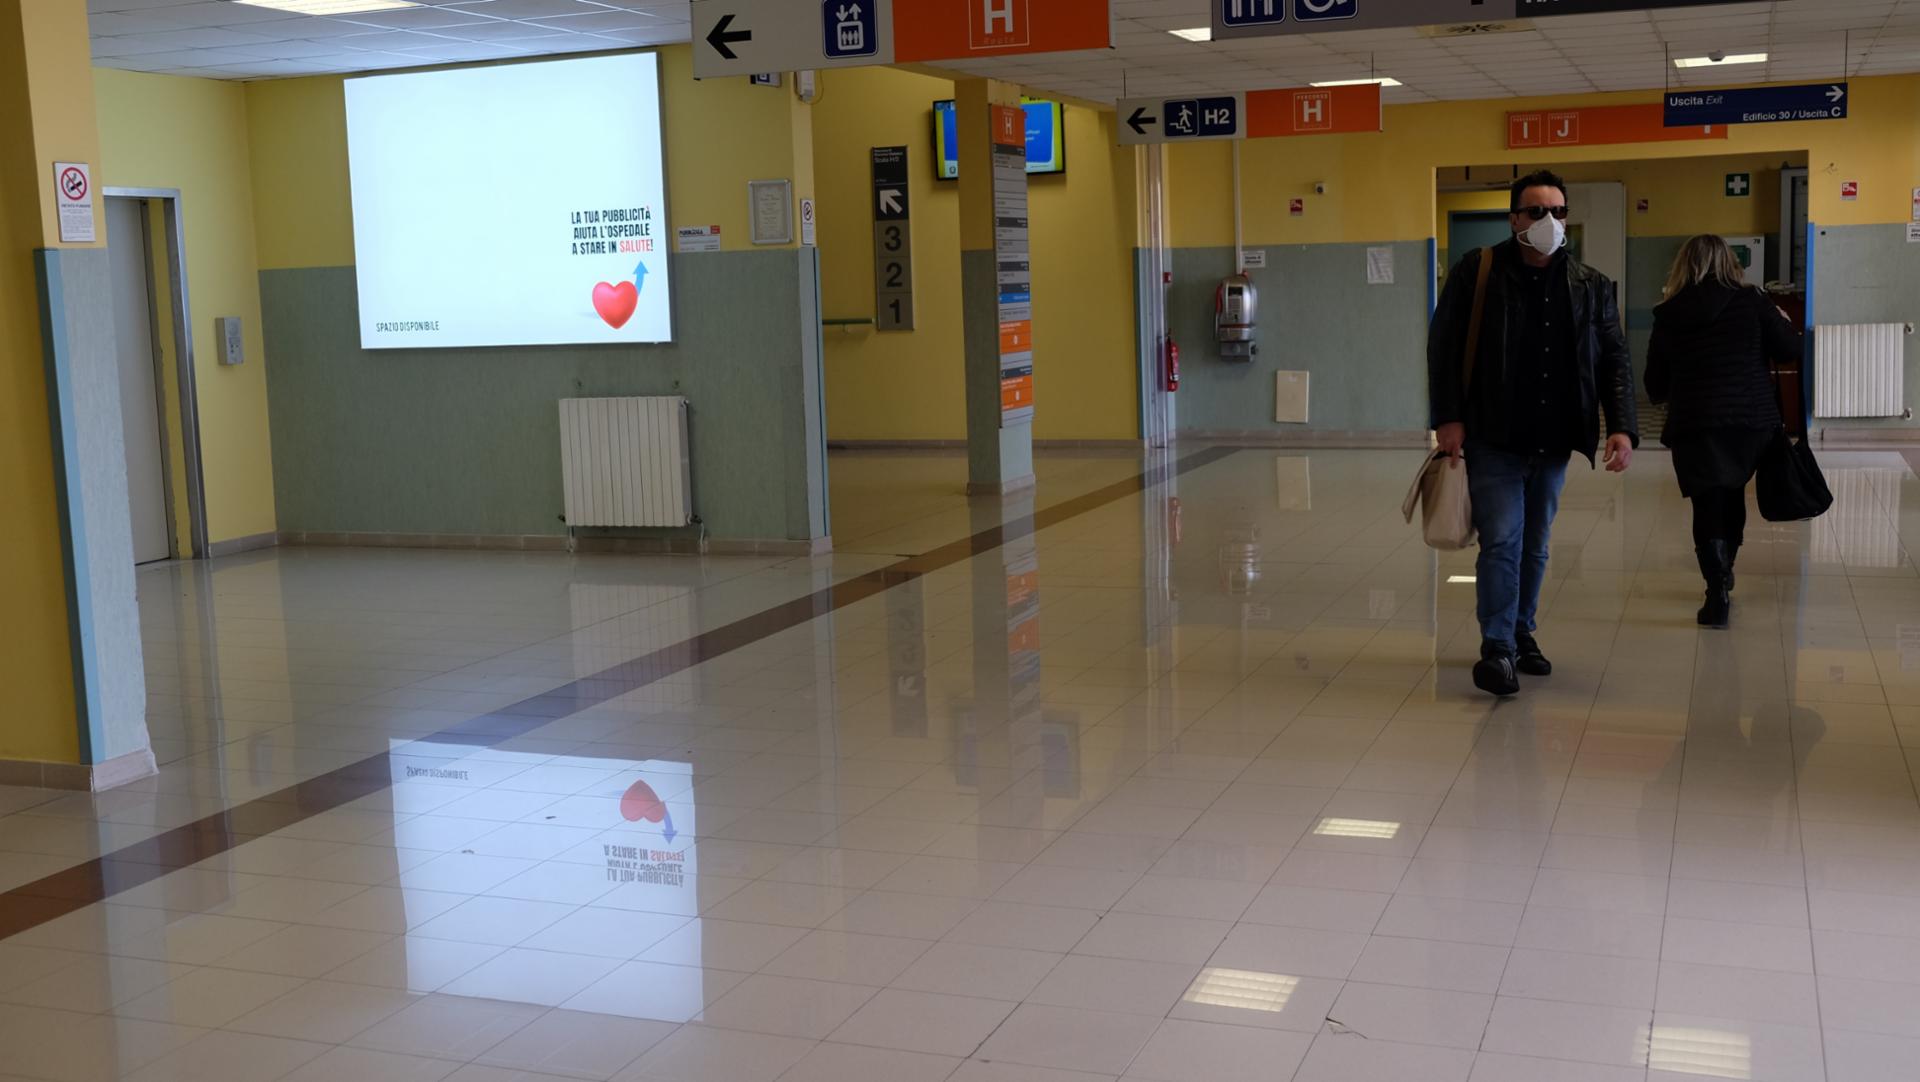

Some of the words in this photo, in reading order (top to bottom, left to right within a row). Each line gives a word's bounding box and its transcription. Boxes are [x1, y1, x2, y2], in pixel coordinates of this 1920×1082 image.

[984, 0, 1013, 34] H
[1670, 97, 1703, 107] Uscita
[1706, 95, 1723, 105] Exit
[1204, 108, 1230, 125] H2
[1303, 100, 1321, 122] H
[1743, 112, 1776, 121] Edificio
[1778, 111, 1790, 119] 30
[1798, 110, 1828, 118] Uscita
[1831, 106, 1841, 117] C
[1523, 121, 1528, 138] I
[1557, 119, 1569, 137] J
[571, 211, 581, 224] LA
[584, 210, 599, 223] TUA
[602, 205, 651, 222] PUBBLICITÀ
[574, 226, 598, 239] AIUTA
[600, 223, 650, 238] L'OSPEDALE
[884, 226, 901, 251] 3
[572, 242, 578, 255] A
[580, 241, 606, 255] STARE
[609, 241, 617, 253] IN
[619, 239, 654, 253] SALUTE!
[886, 262, 903, 288] 2
[889, 298, 901, 323] 1
[376, 322, 399, 332] SPAZIO
[400, 321, 440, 331] DISPONIBILE
